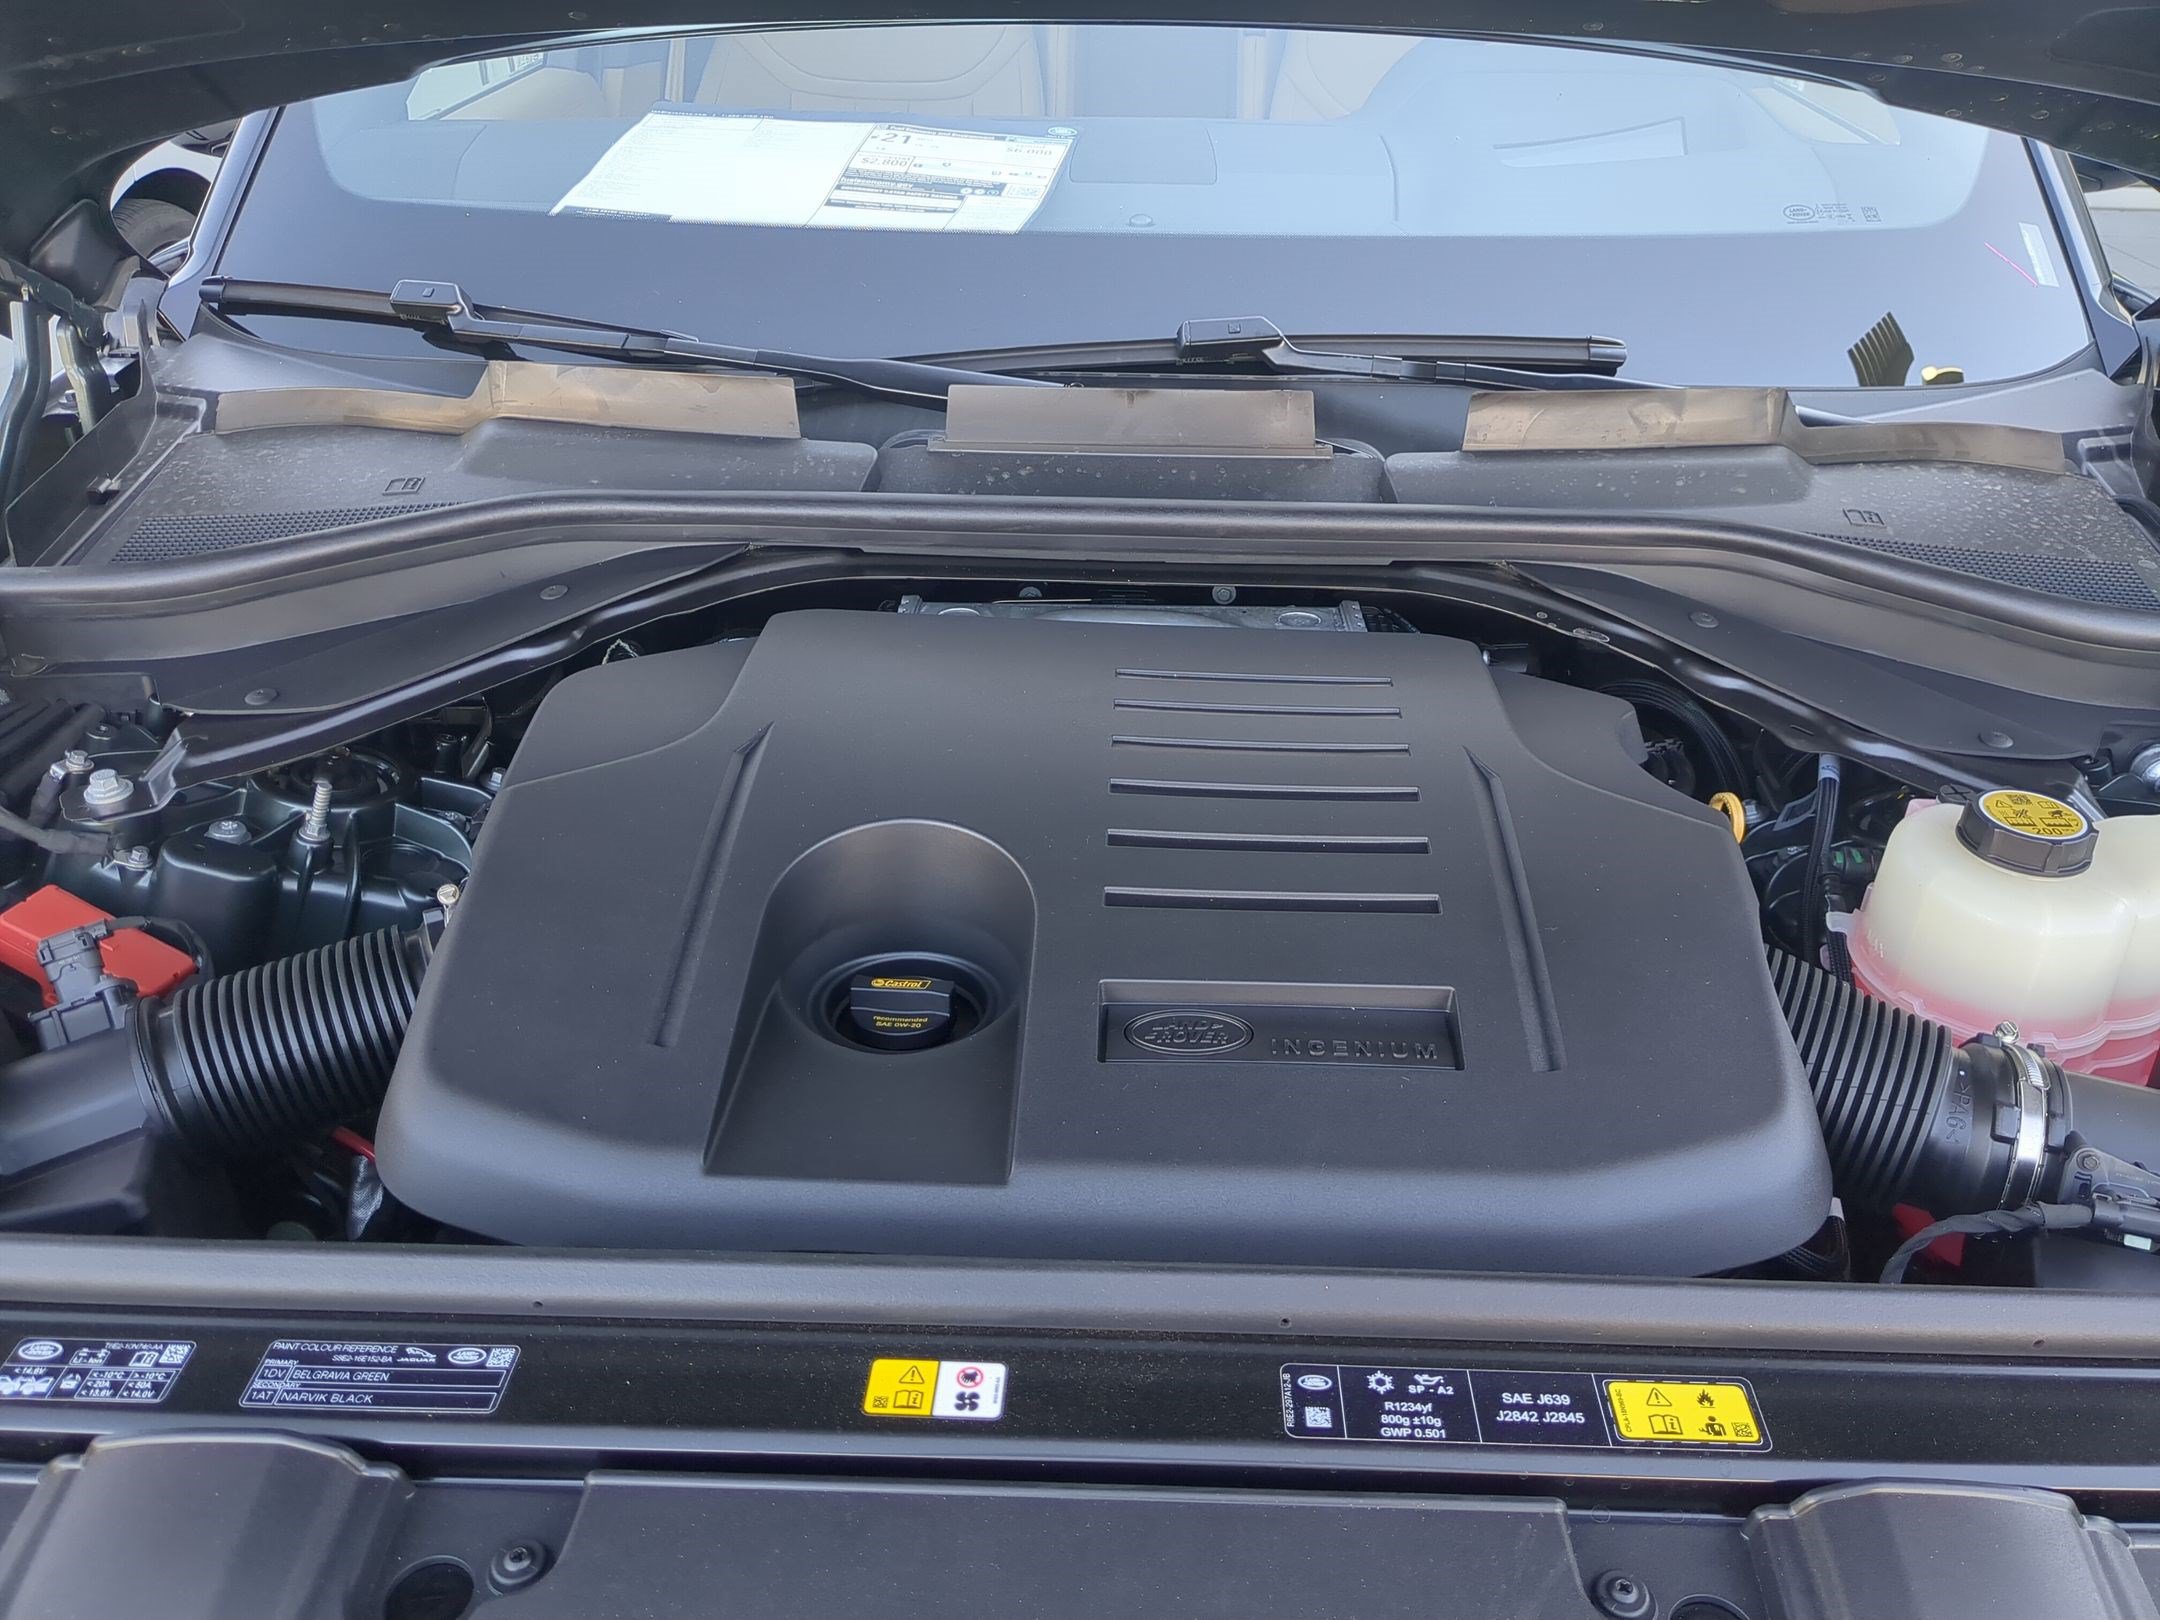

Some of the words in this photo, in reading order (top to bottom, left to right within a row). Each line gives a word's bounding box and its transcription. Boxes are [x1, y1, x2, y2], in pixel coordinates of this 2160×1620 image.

[880, 132, 912, 144] 21
[2032, 827, 2062, 835] 200
[885, 980, 922, 988] Castrol
[1157, 1031, 1229, 1045] ROVER
[1271, 1038, 1438, 1060] INGENIUM
[273, 1342, 300, 1350] PAINT
[300, 1343, 342, 1352] COLOUR
[342, 1344, 399, 1353] REFERENCE
[263, 1368, 287, 1378] 1DV
[292, 1369, 350, 1381] BELGRAVIA
[352, 1371, 390, 1382] GREEN
[251, 1381, 301, 1389] SECONDARY
[251, 1390, 274, 1400] 1AT
[281, 1391, 328, 1402] NARVIK
[330, 1393, 373, 1404] BLACK
[1501, 1392, 1534, 1404] SAE
[1536, 1394, 1571, 1406] J639
[1384, 1401, 1433, 1413] R1234yf
[1381, 1415, 1410, 1426] 800g
[1412, 1416, 1441, 1427] ±10g
[1496, 1410, 1539, 1422] J2842
[1542, 1412, 1586, 1424] J2845
[1381, 1427, 1411, 1438] GWP
[1414, 1428, 1446, 1439] 0.501
